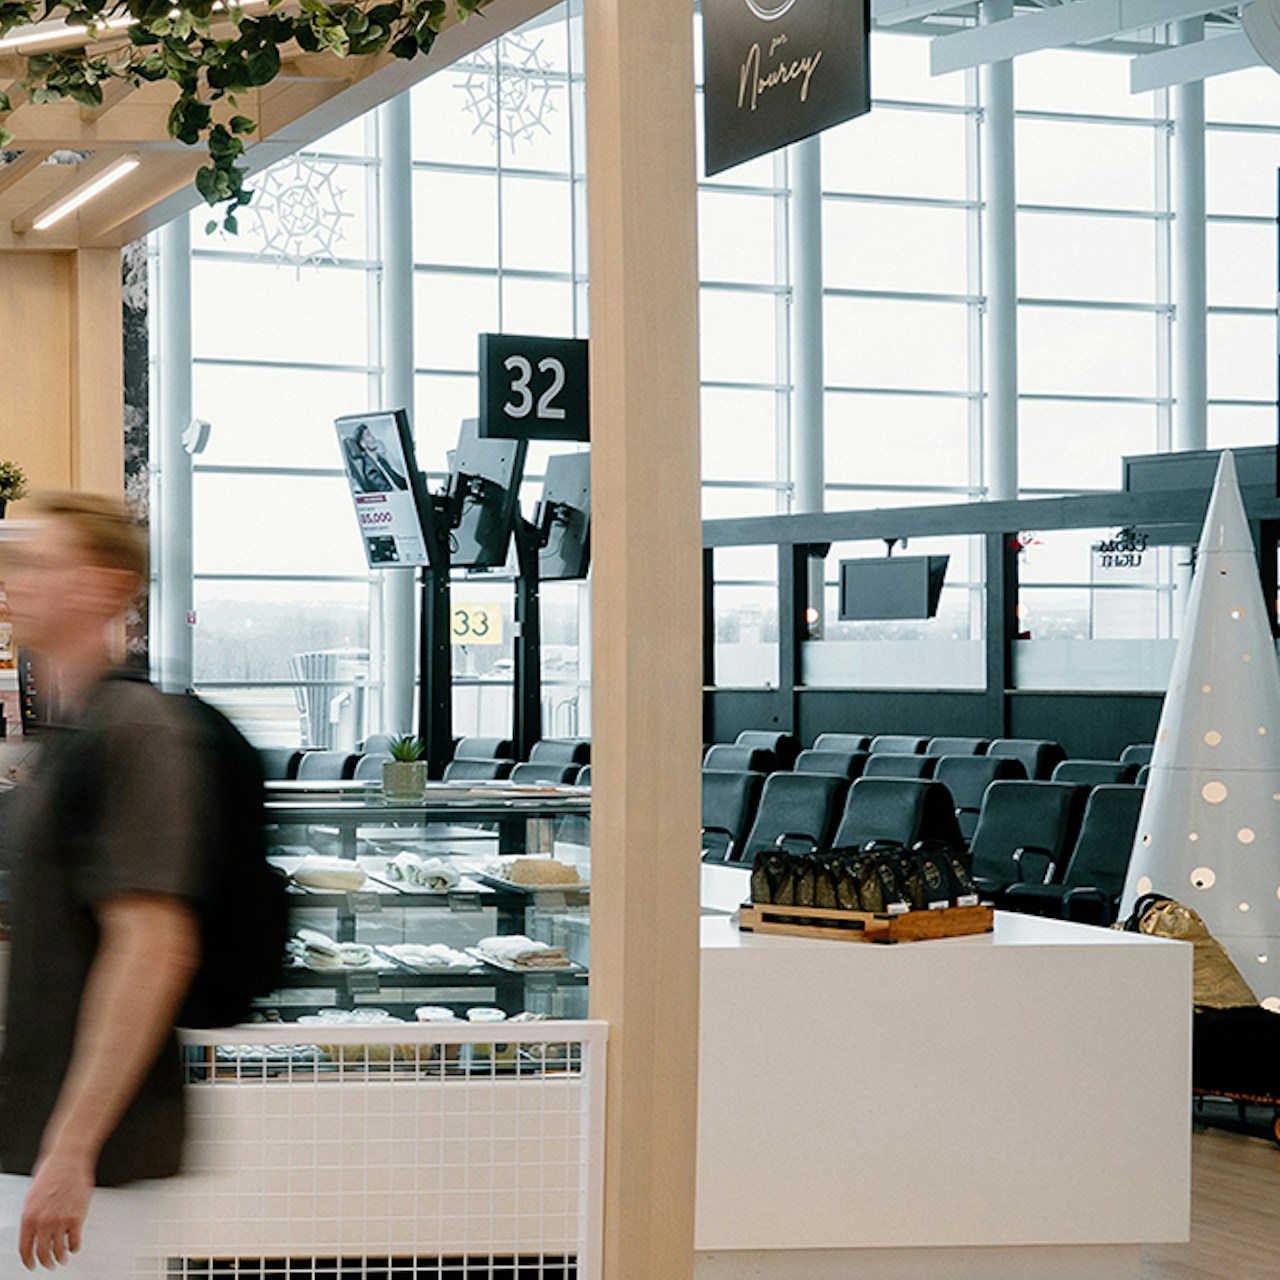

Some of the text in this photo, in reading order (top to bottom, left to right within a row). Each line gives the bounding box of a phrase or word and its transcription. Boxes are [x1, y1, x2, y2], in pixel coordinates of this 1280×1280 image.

[768, 33, 789, 57] par
[737, 42, 823, 111] Nourcy
[503, 355, 566, 420] 32
[453, 611, 489, 637] 33
